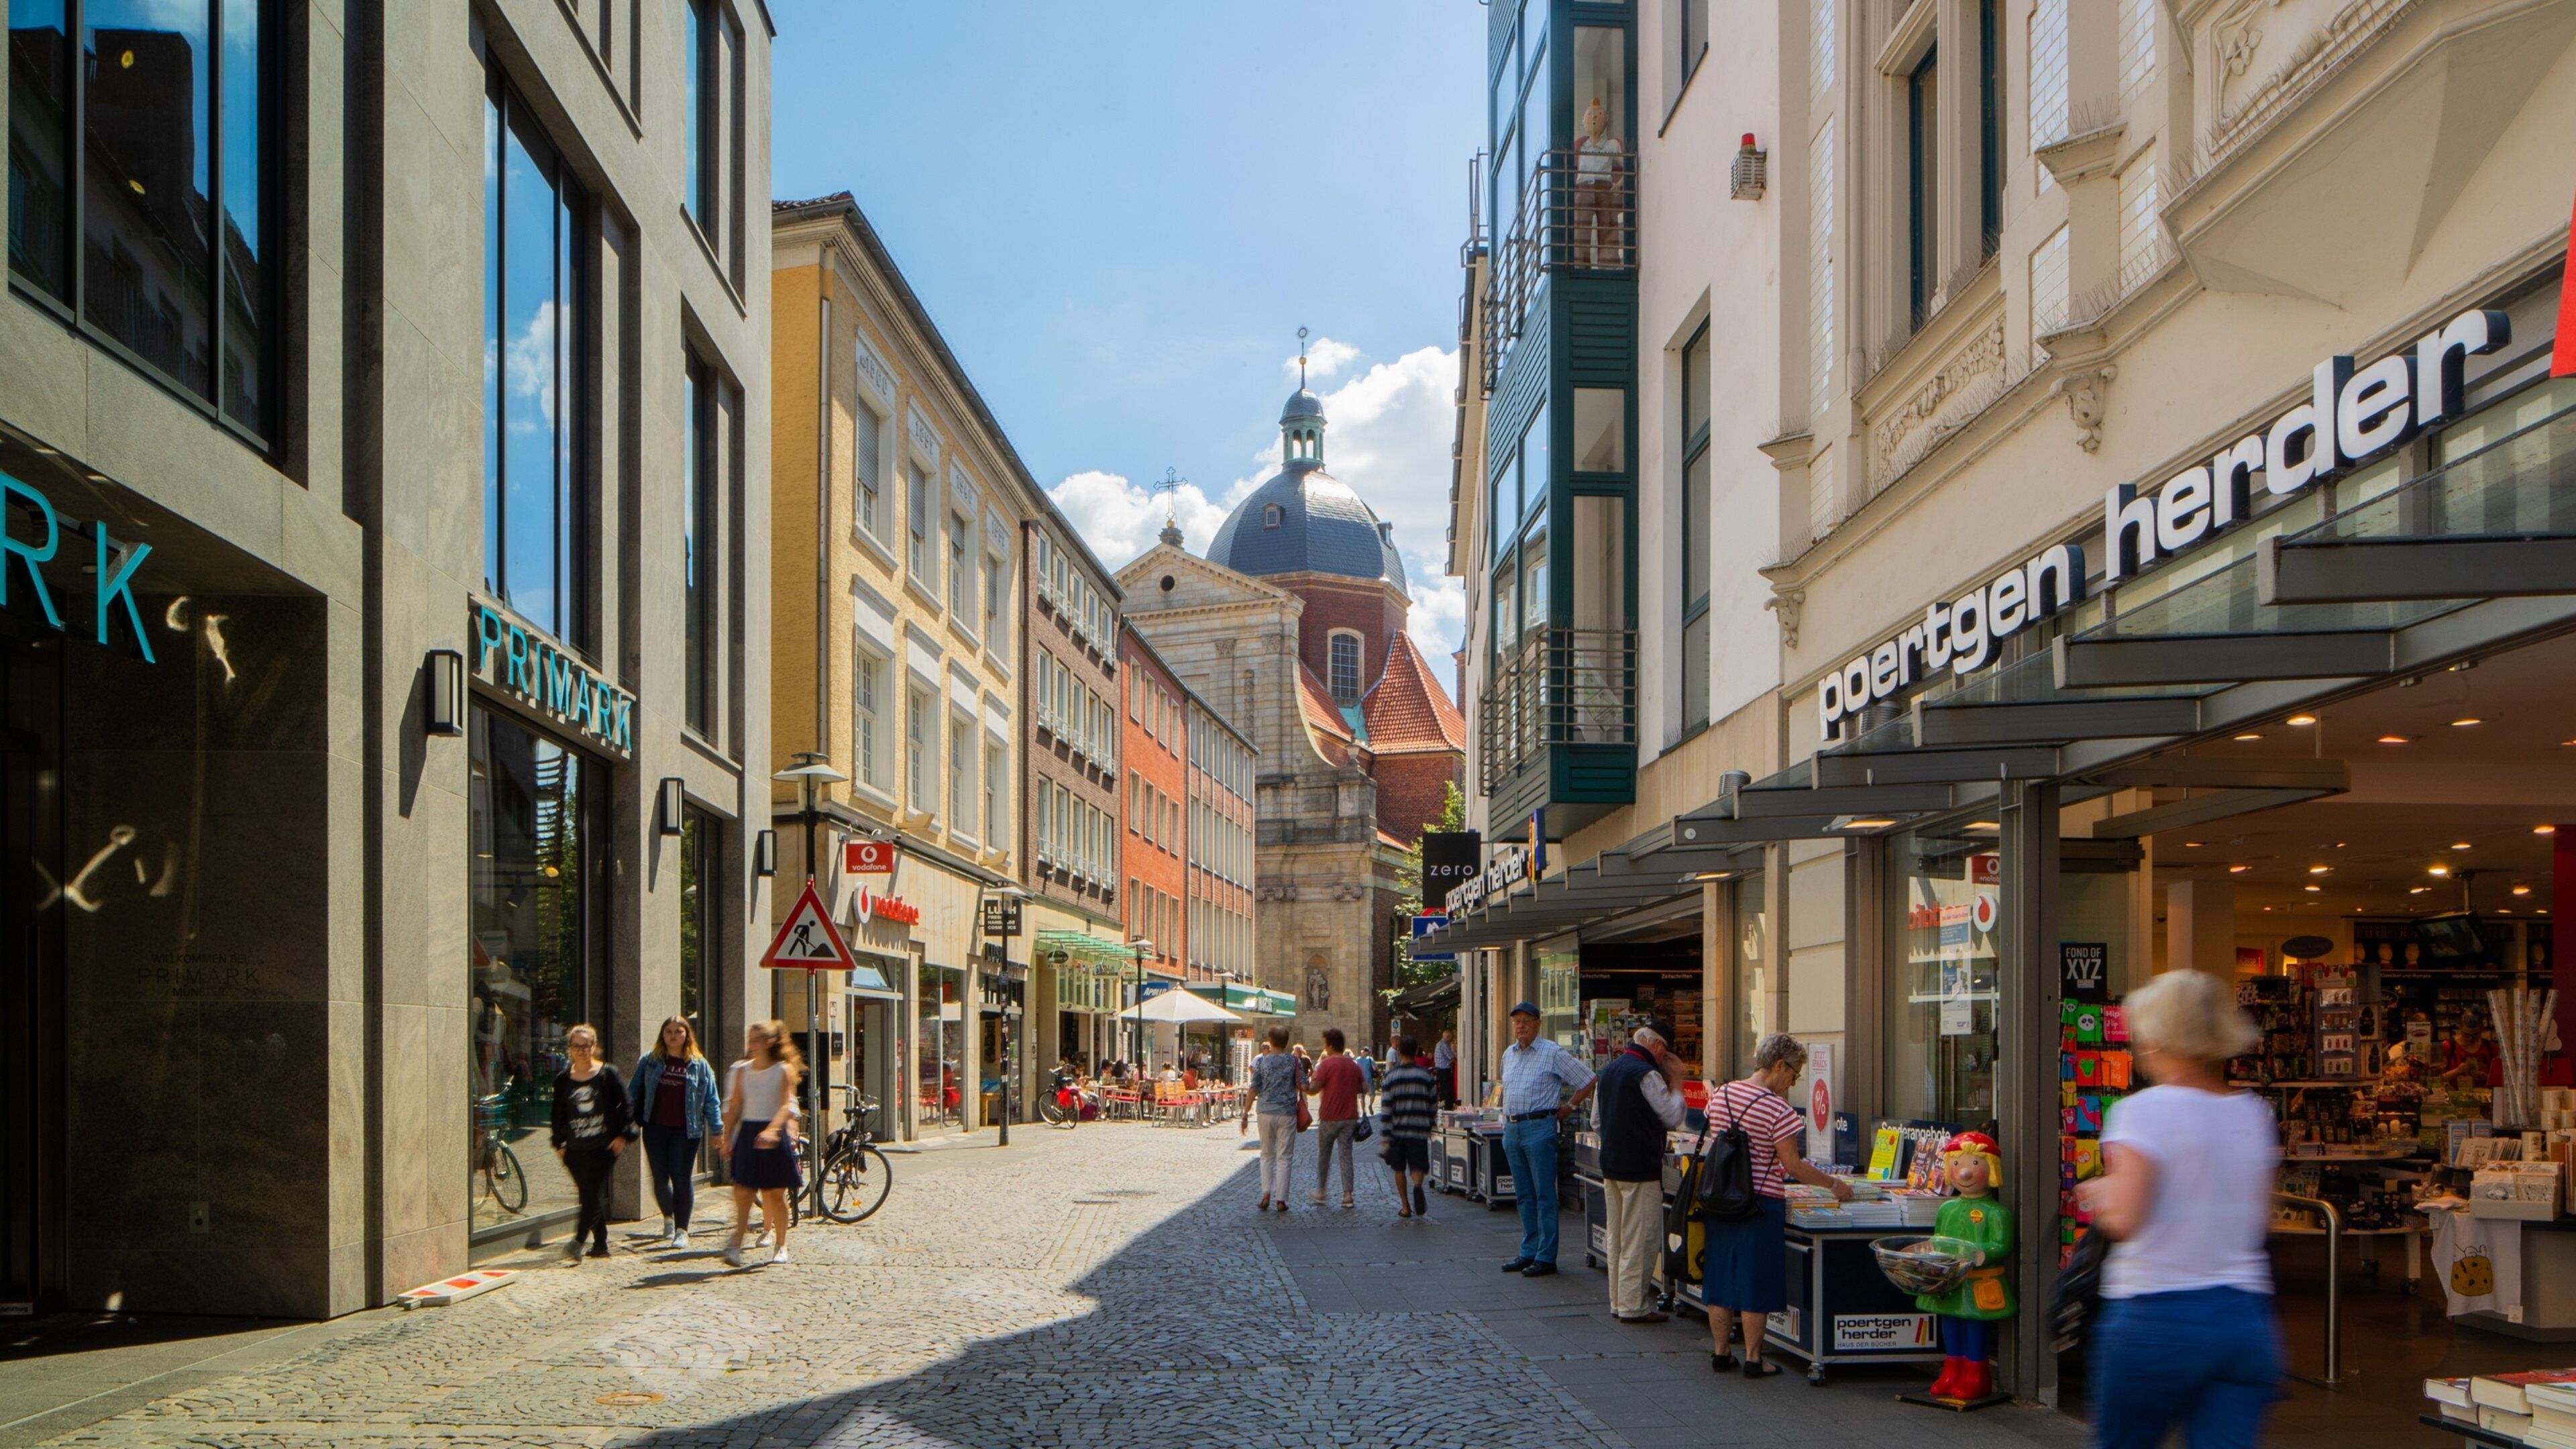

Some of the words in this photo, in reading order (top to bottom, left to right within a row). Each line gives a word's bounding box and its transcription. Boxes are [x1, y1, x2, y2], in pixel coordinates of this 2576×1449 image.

[1819, 544, 2081, 741] poertgen
[2105, 309, 2504, 582] herder
[480, 605, 632, 752] PRIMARK
[1430, 865, 1473, 875] zero
[1445, 874, 1485, 920] poertgen
[1487, 849, 1525, 893] herder
[873, 893, 919, 926] vodafone
[987, 906, 1017, 915] LUH
[2065, 947, 2089, 958] FOND
[2090, 947, 2102, 957] OF
[151, 954, 227, 964] WILLKOMMEN
[2065, 959, 2102, 979] XYZ
[138, 967, 260, 985] PRIMARK
[172, 984, 225, 997] MÜNSTER
[2106, 1010, 2121, 1019] Hip
[1837, 1318, 1911, 1330] poertgen
[1842, 1329, 1897, 1340] herder
